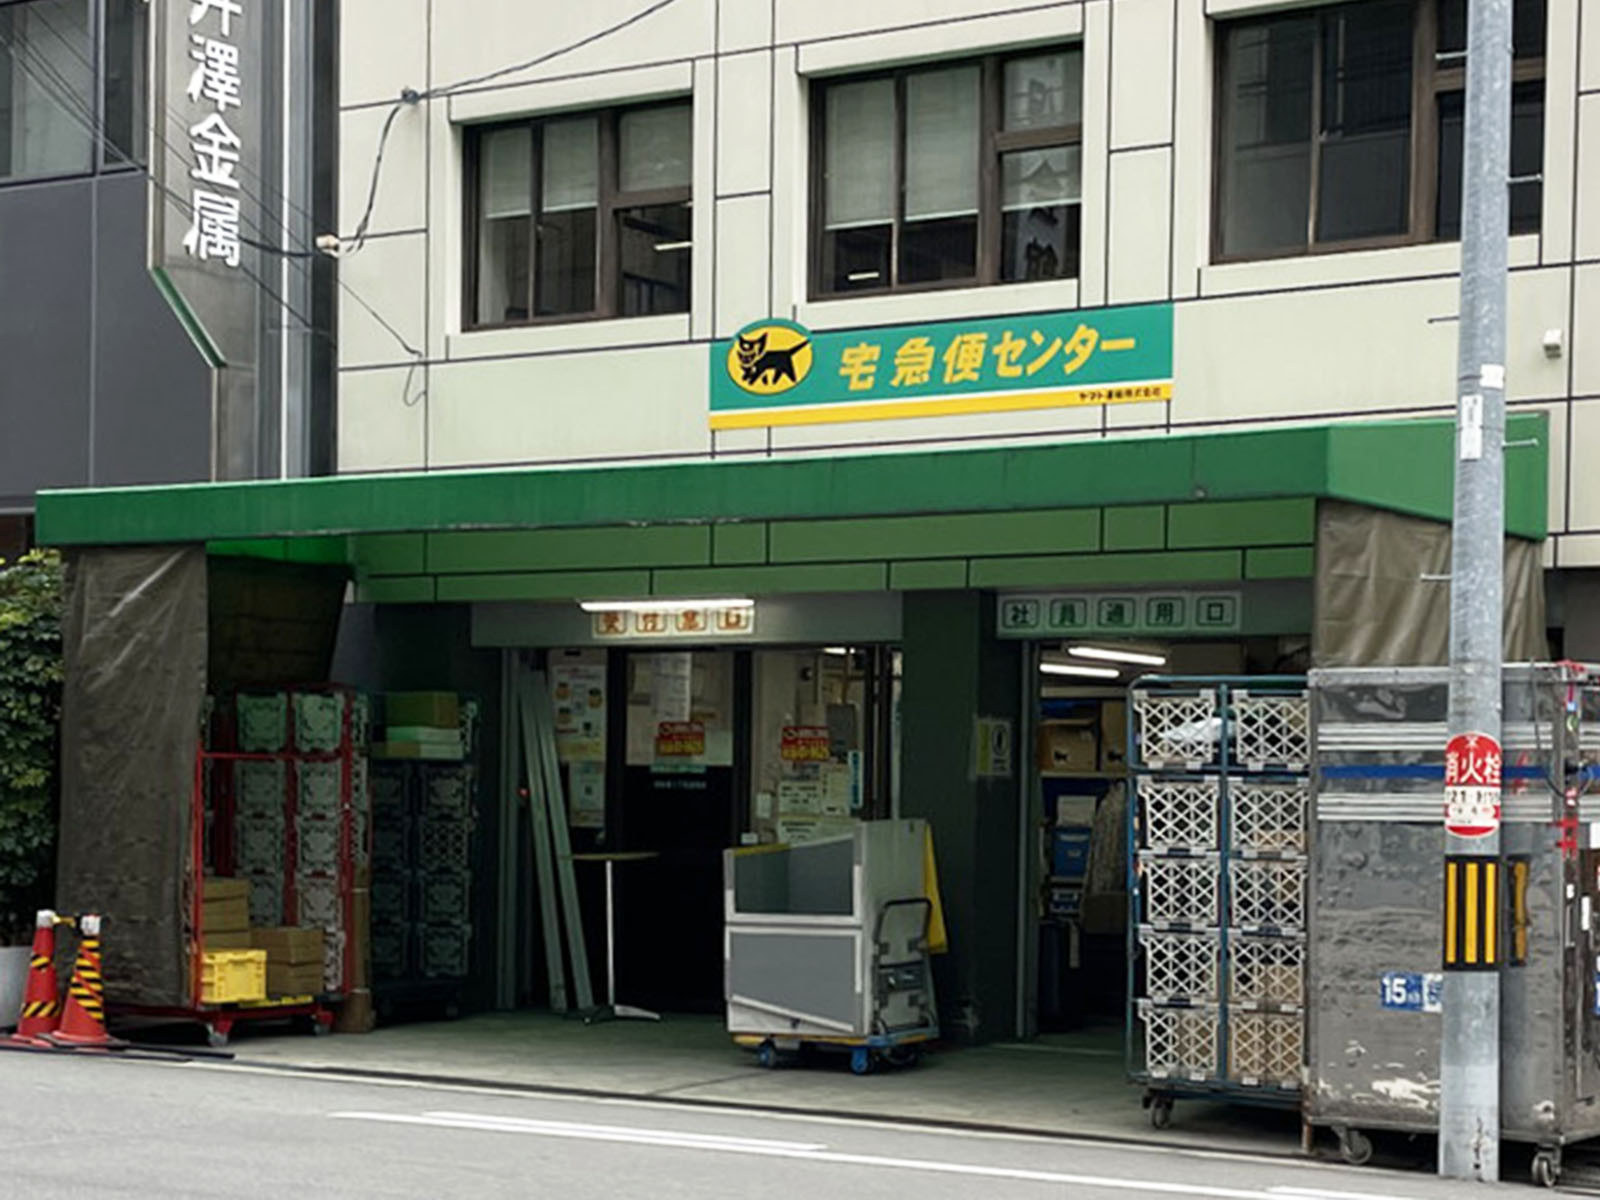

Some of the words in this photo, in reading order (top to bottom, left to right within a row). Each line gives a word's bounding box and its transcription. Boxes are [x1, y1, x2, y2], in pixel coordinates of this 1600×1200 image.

[839, 324, 1136, 390] 宅急便センター
[1011, 602, 1224, 626] 社員通用口
